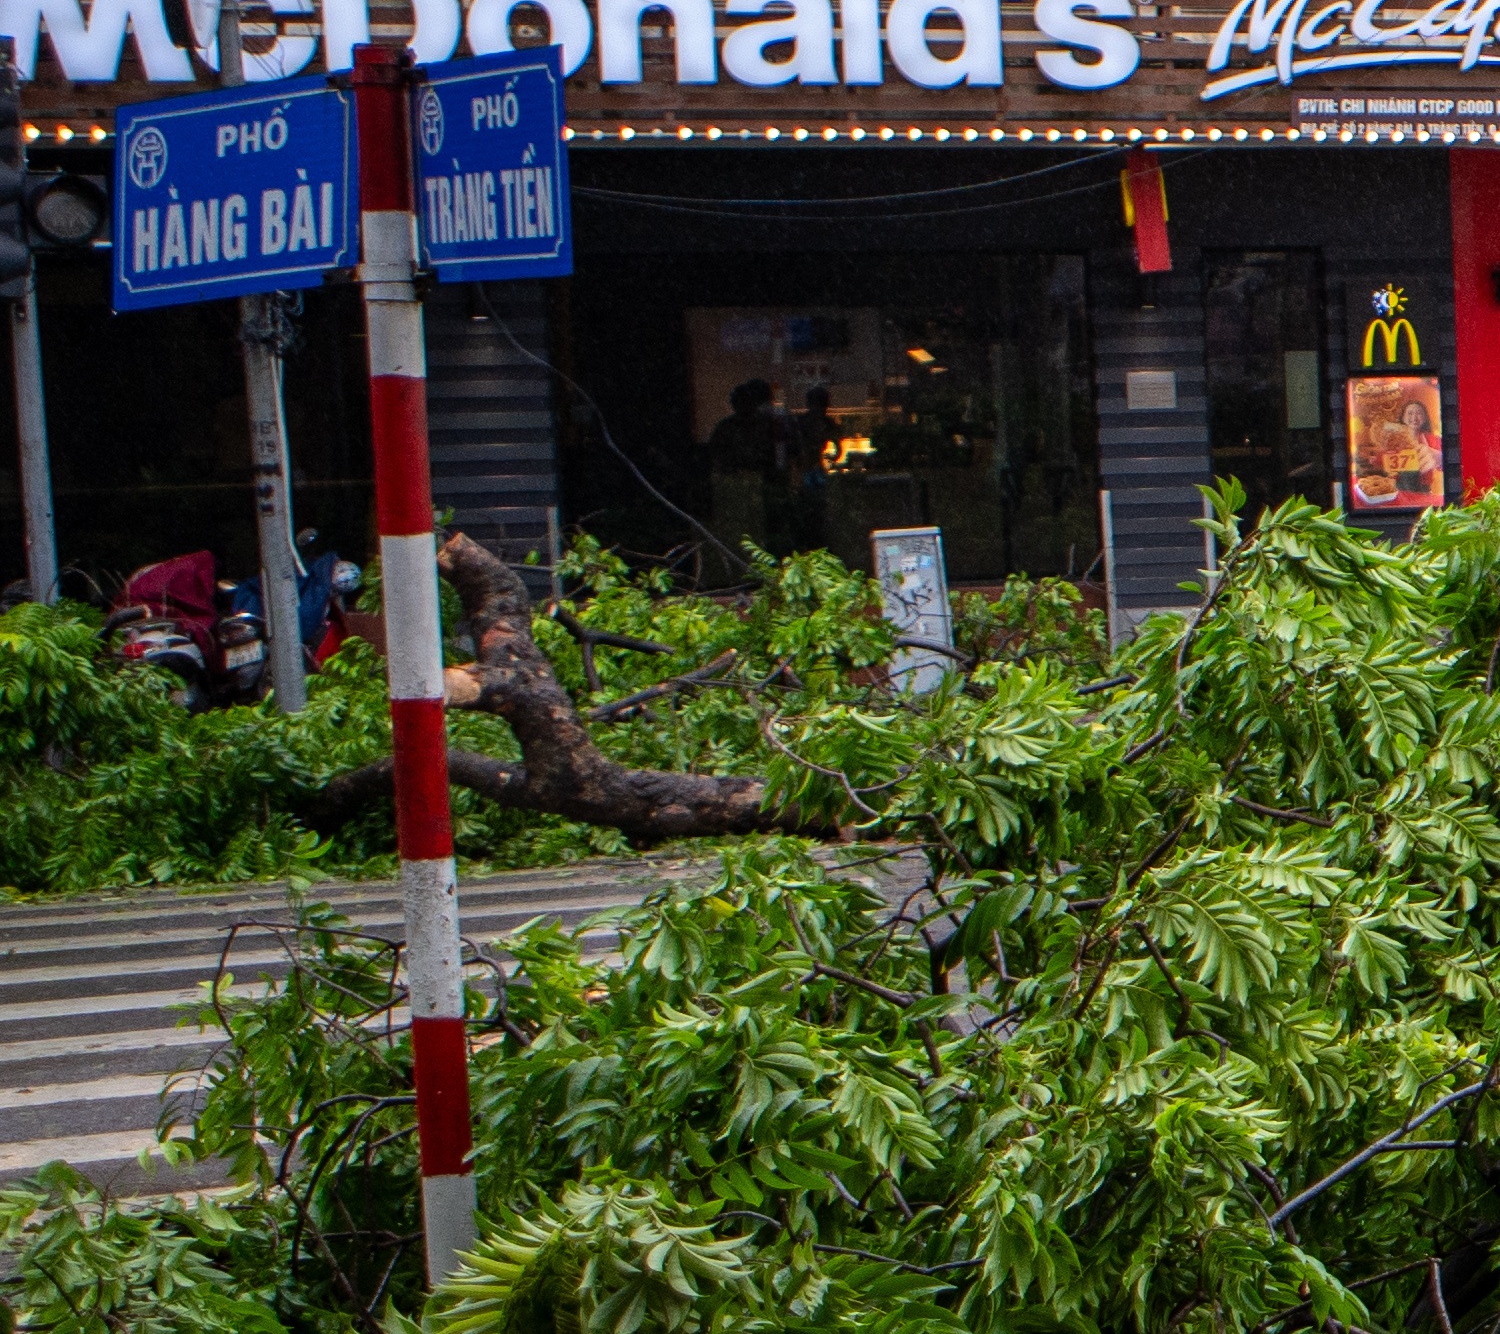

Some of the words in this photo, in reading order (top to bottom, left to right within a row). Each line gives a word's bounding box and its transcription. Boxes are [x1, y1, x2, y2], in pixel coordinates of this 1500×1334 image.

[216, 102, 290, 158] PHỐ
[471, 75, 520, 132] PHỐ
[1341, 99, 1365, 114] CHI
[1368, 97, 1416, 114] NHÁNH
[1419, 99, 1454, 114] CTCP
[1457, 100, 1494, 115] GOOD
[131, 183, 249, 273] HÀNG
[260, 169, 334, 257] BÀI
[425, 158, 498, 244] TRÀNG
[501, 143, 555, 240] TIỀN
